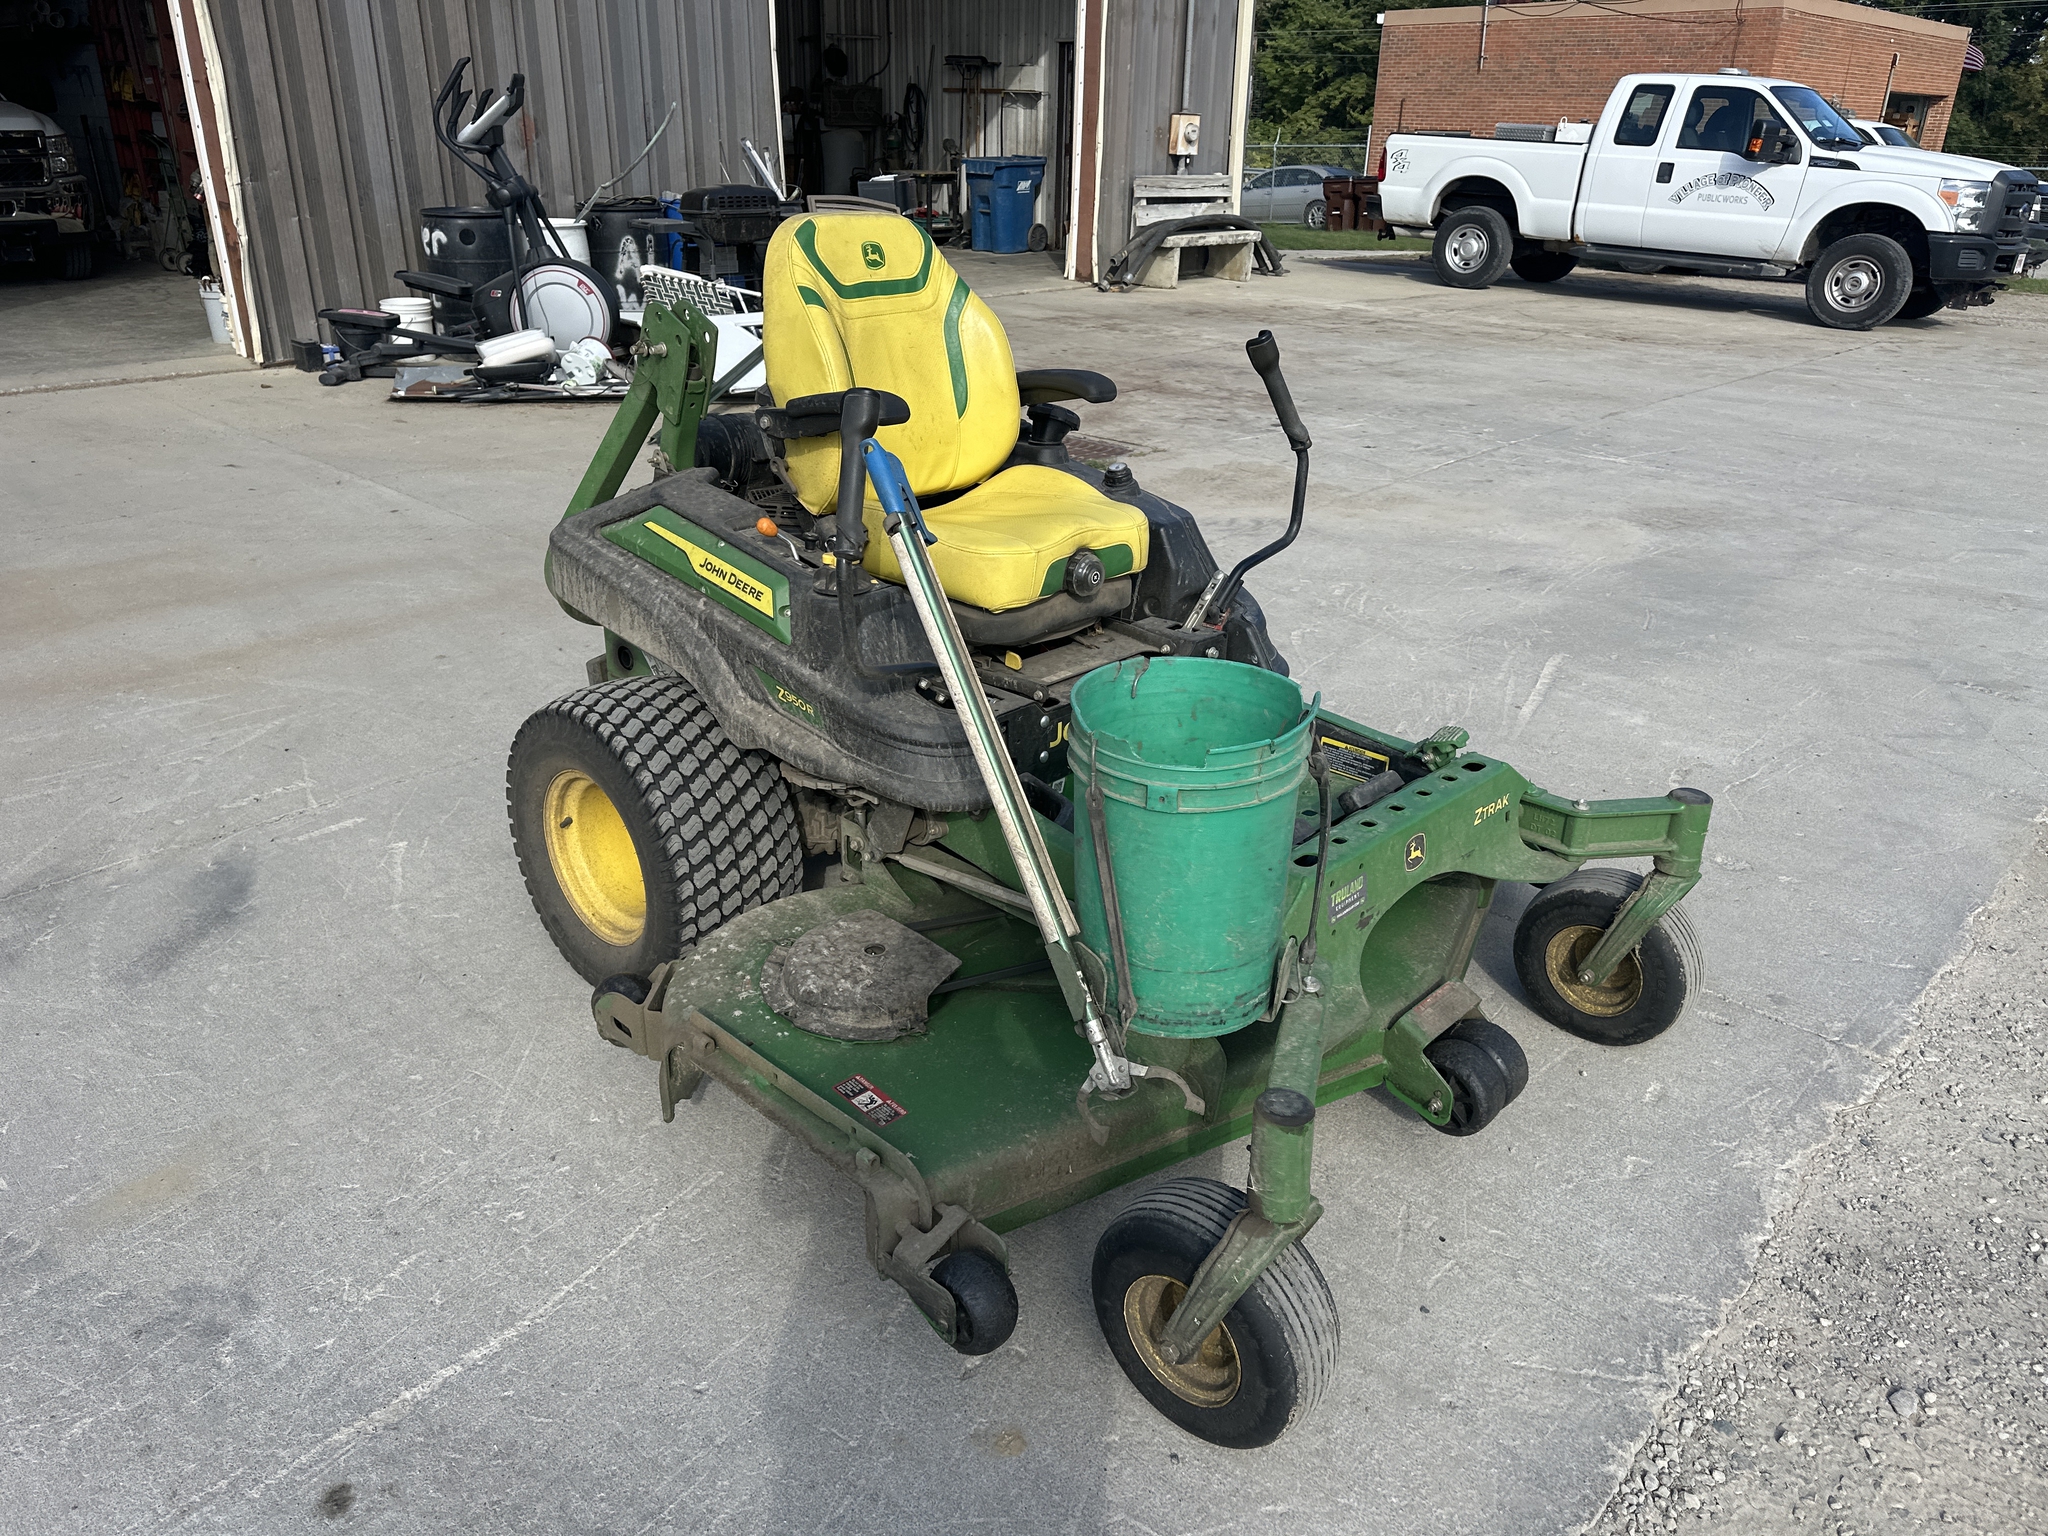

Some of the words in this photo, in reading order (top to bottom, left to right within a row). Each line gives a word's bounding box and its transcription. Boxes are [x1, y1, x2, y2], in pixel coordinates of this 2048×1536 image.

[1668, 173, 1717, 205] VILLAGE
[1716, 172, 1731, 186] of
[1730, 172, 1775, 212] PIONEER
[1697, 193, 1721, 203] PUBLIC
[1721, 194, 1749, 205] WORKS
[699, 557, 728, 581] JOHN
[727, 572, 764, 602] DEERE
[775, 685, 815, 717] Z950R
[1473, 793, 1510, 827] ZTRAK
